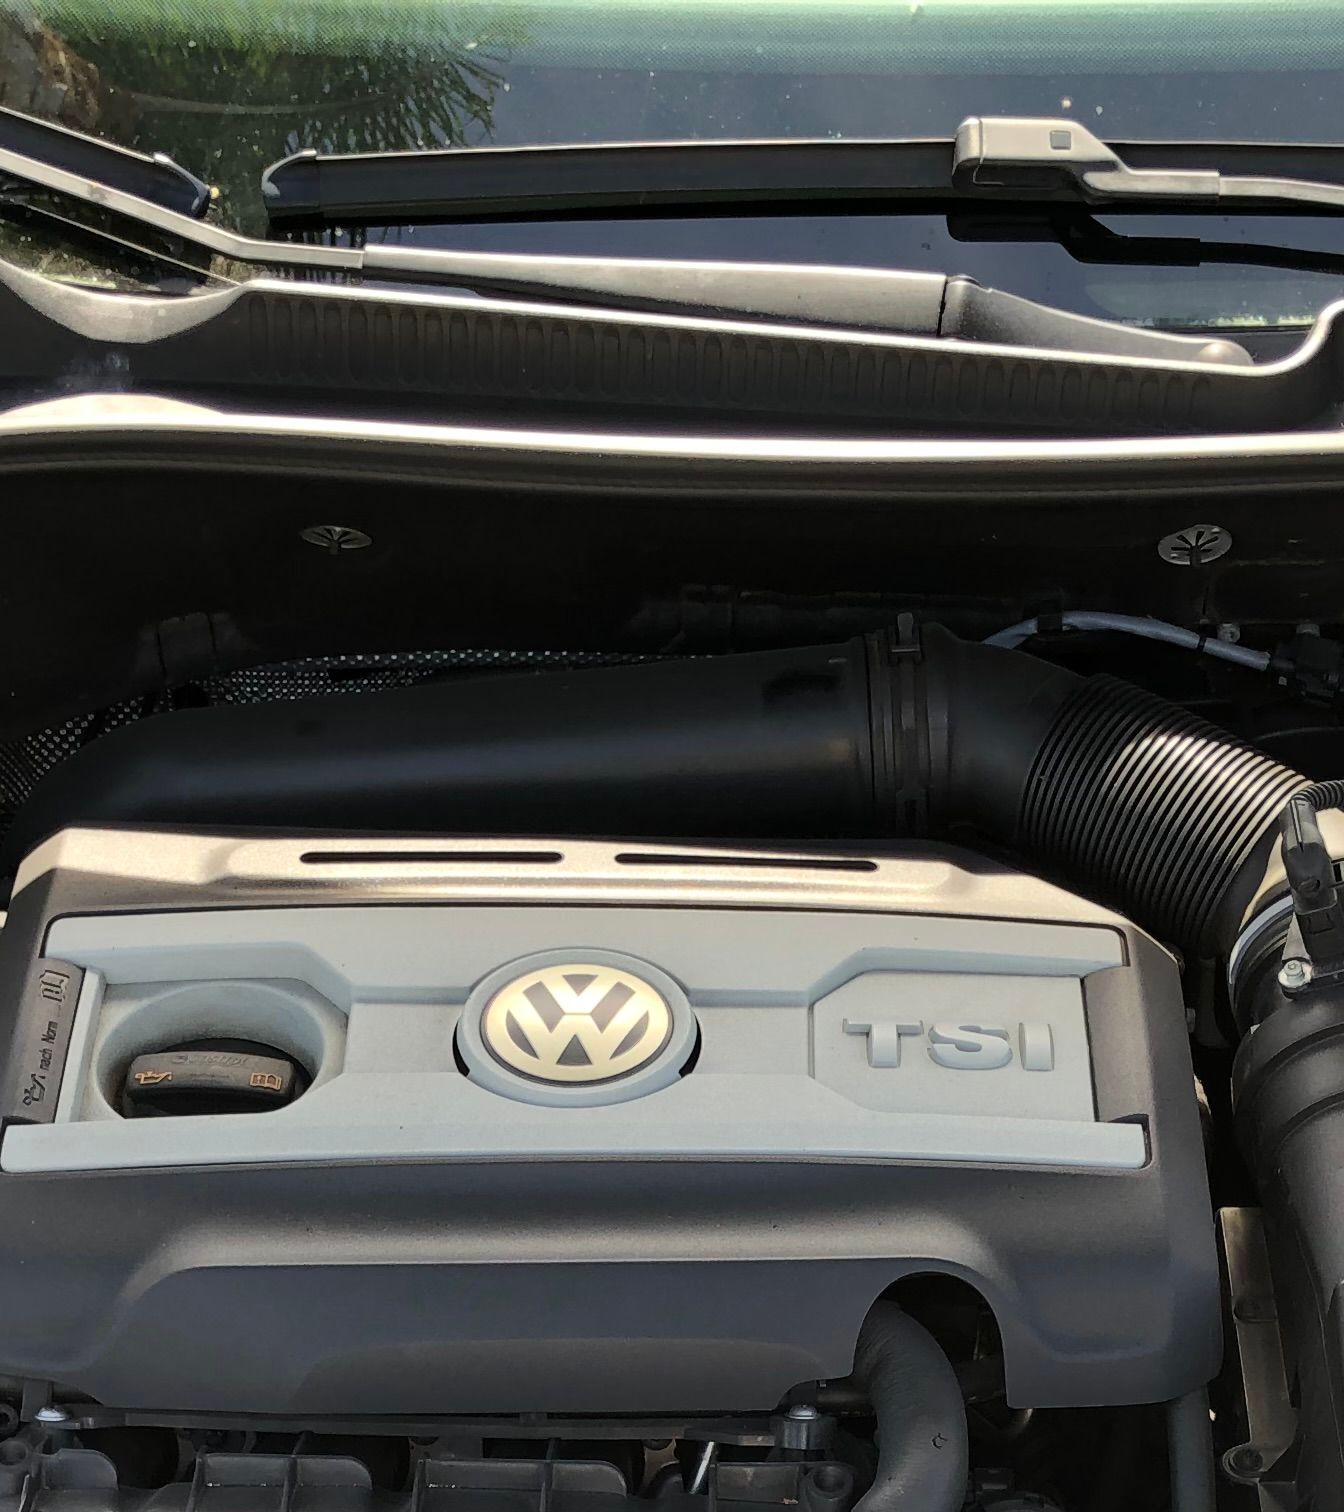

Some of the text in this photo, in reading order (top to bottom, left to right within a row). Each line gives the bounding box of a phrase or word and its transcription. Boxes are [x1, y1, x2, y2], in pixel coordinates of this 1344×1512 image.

[40, 1021, 58, 1071] nach Norm
[842, 1018, 1055, 1071] TSI
